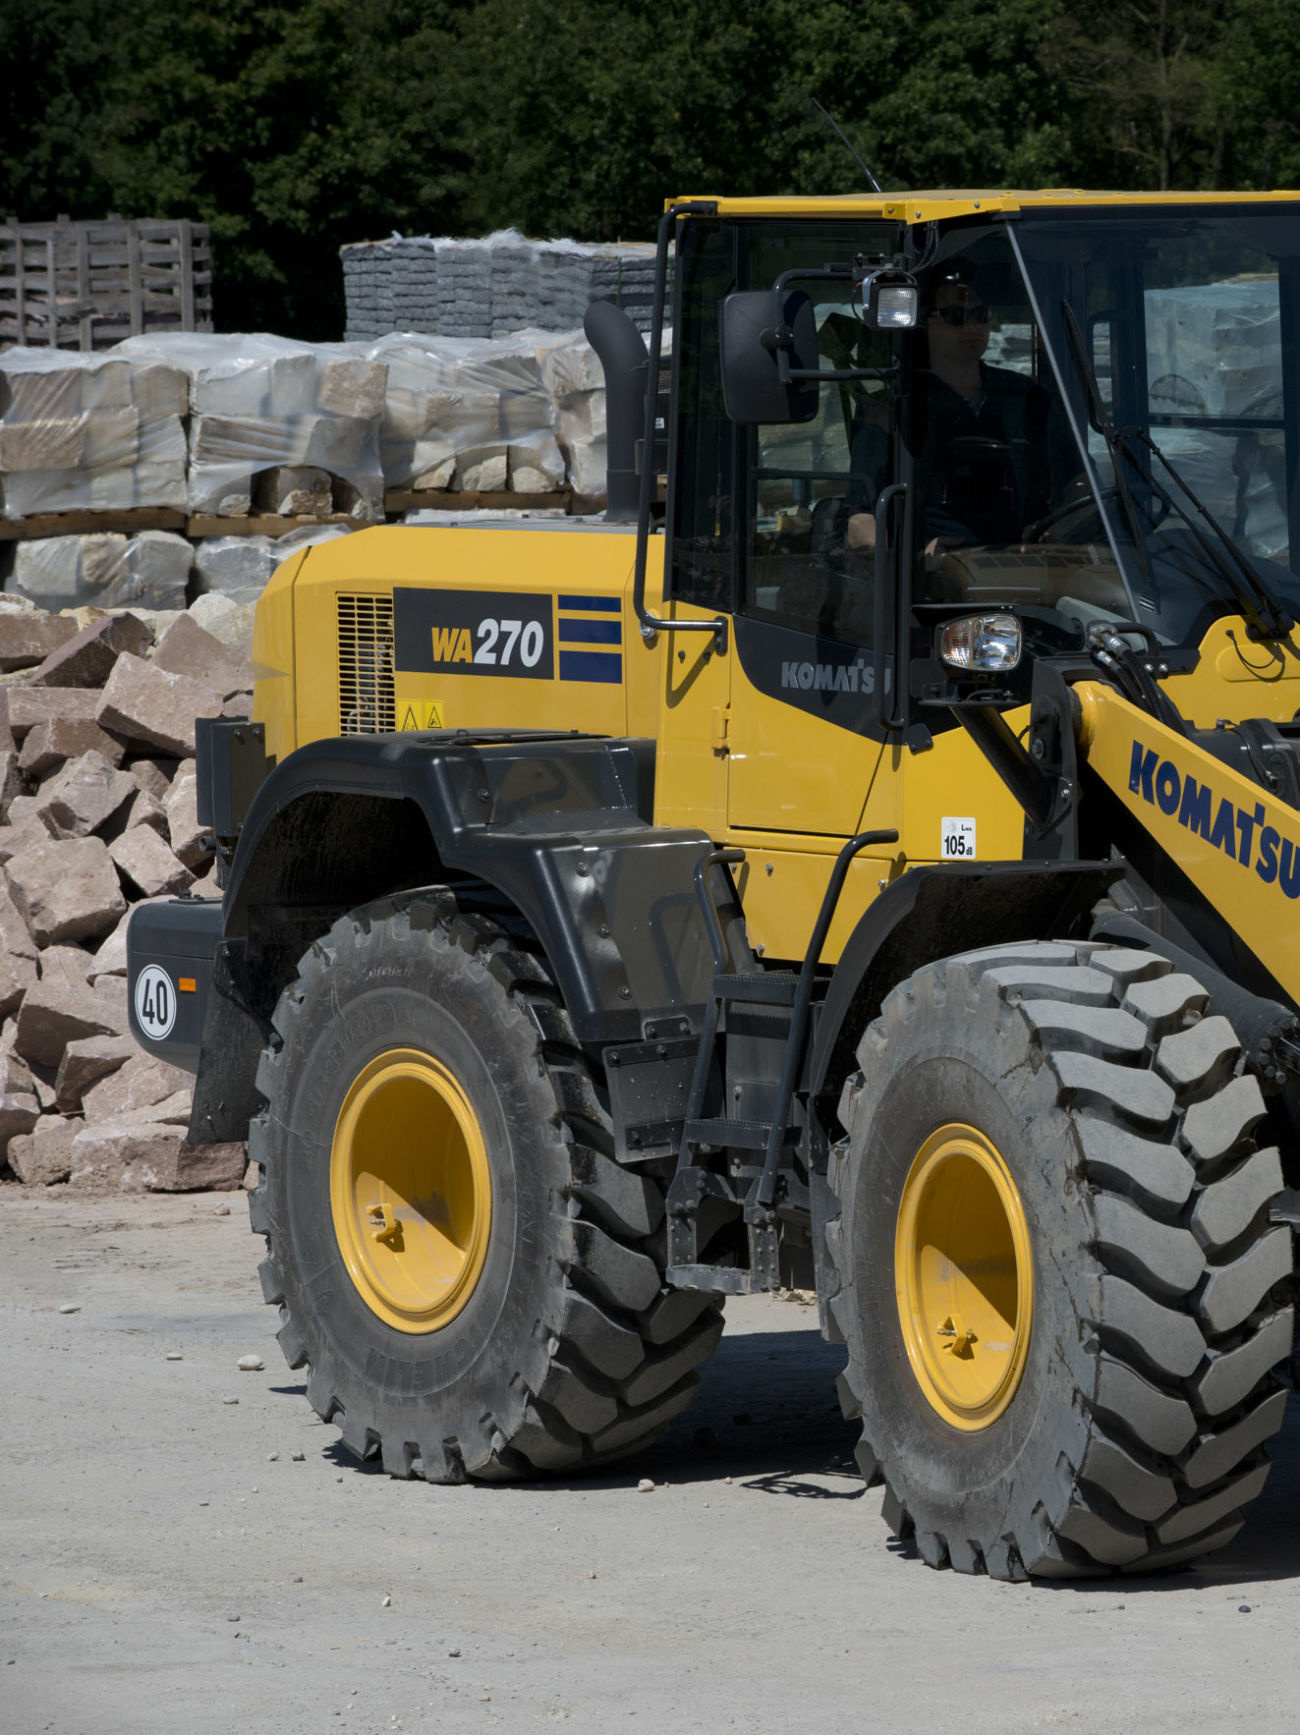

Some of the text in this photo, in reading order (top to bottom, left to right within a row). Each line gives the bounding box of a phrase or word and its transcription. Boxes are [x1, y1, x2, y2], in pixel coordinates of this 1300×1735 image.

[431, 618, 545, 668] WA270
[944, 835, 966, 856] 105
[142, 978, 169, 1026] 40
